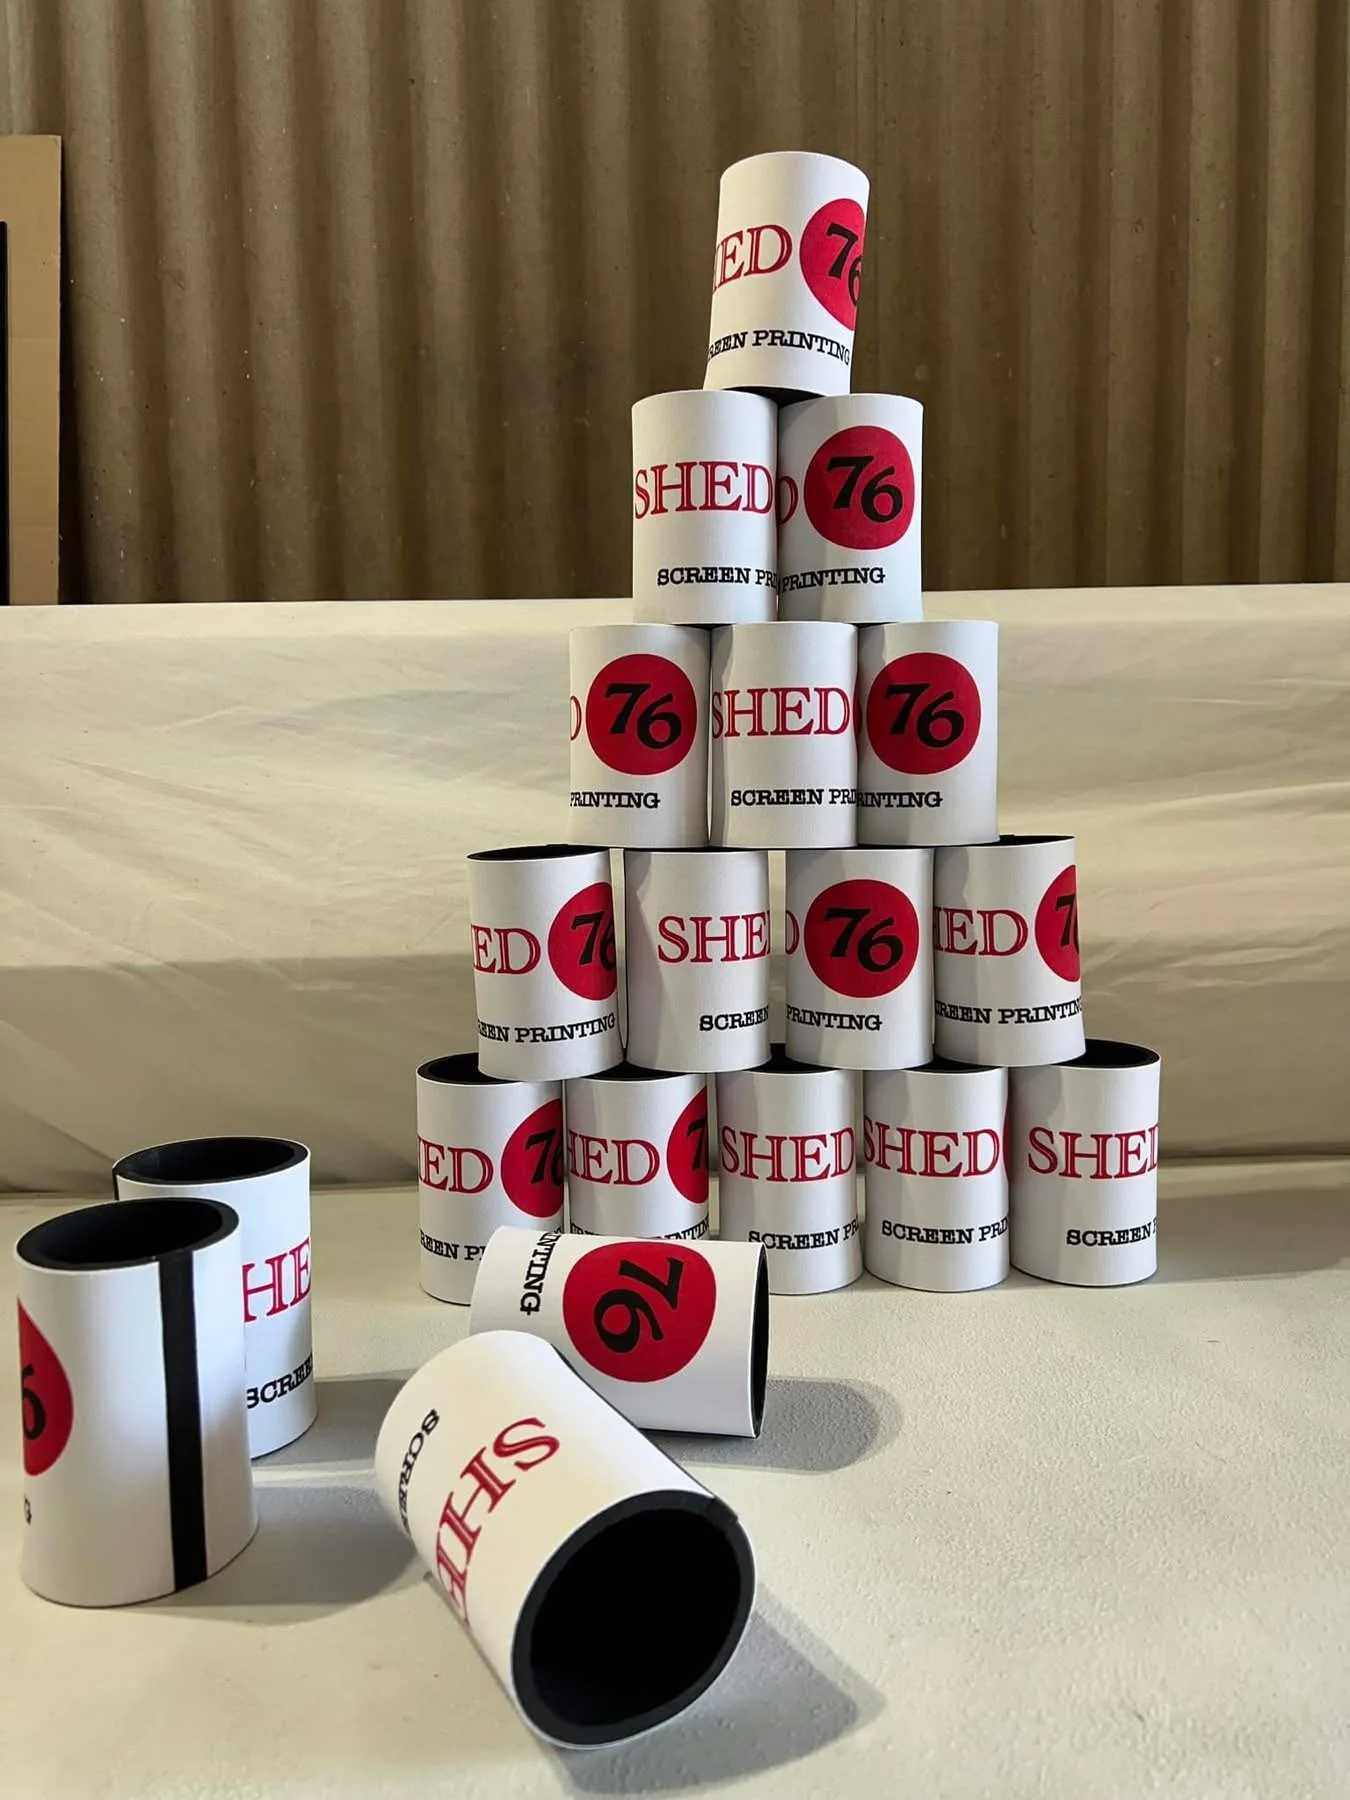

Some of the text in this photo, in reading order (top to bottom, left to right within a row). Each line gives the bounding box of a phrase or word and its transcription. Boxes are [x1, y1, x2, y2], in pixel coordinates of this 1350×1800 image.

[713, 224, 792, 292] ED
[752, 330, 850, 365] PRINTING
[635, 461, 773, 519] SHED
[826, 456, 903, 523] 76
[657, 567, 751, 586] SCREEN
[782, 567, 886, 593] PRINTING
[604, 683, 682, 749] 76
[712, 687, 850, 738] SHED
[884, 683, 965, 748] 76
[570, 791, 661, 809] PRINTING
[731, 789, 824, 806] SCREEN
[657, 910, 771, 963] SHE
[824, 907, 904, 973] 76
[515, 1012, 616, 1042] PRINTING
[785, 1004, 882, 1031] PRINTING
[721, 1125, 855, 1182] SHED
[864, 1115, 1000, 1177] SHED
[882, 1219, 974, 1244] SCREEN
[1066, 1222, 1151, 1247] SCREEN
[593, 1257, 684, 1353] 76
